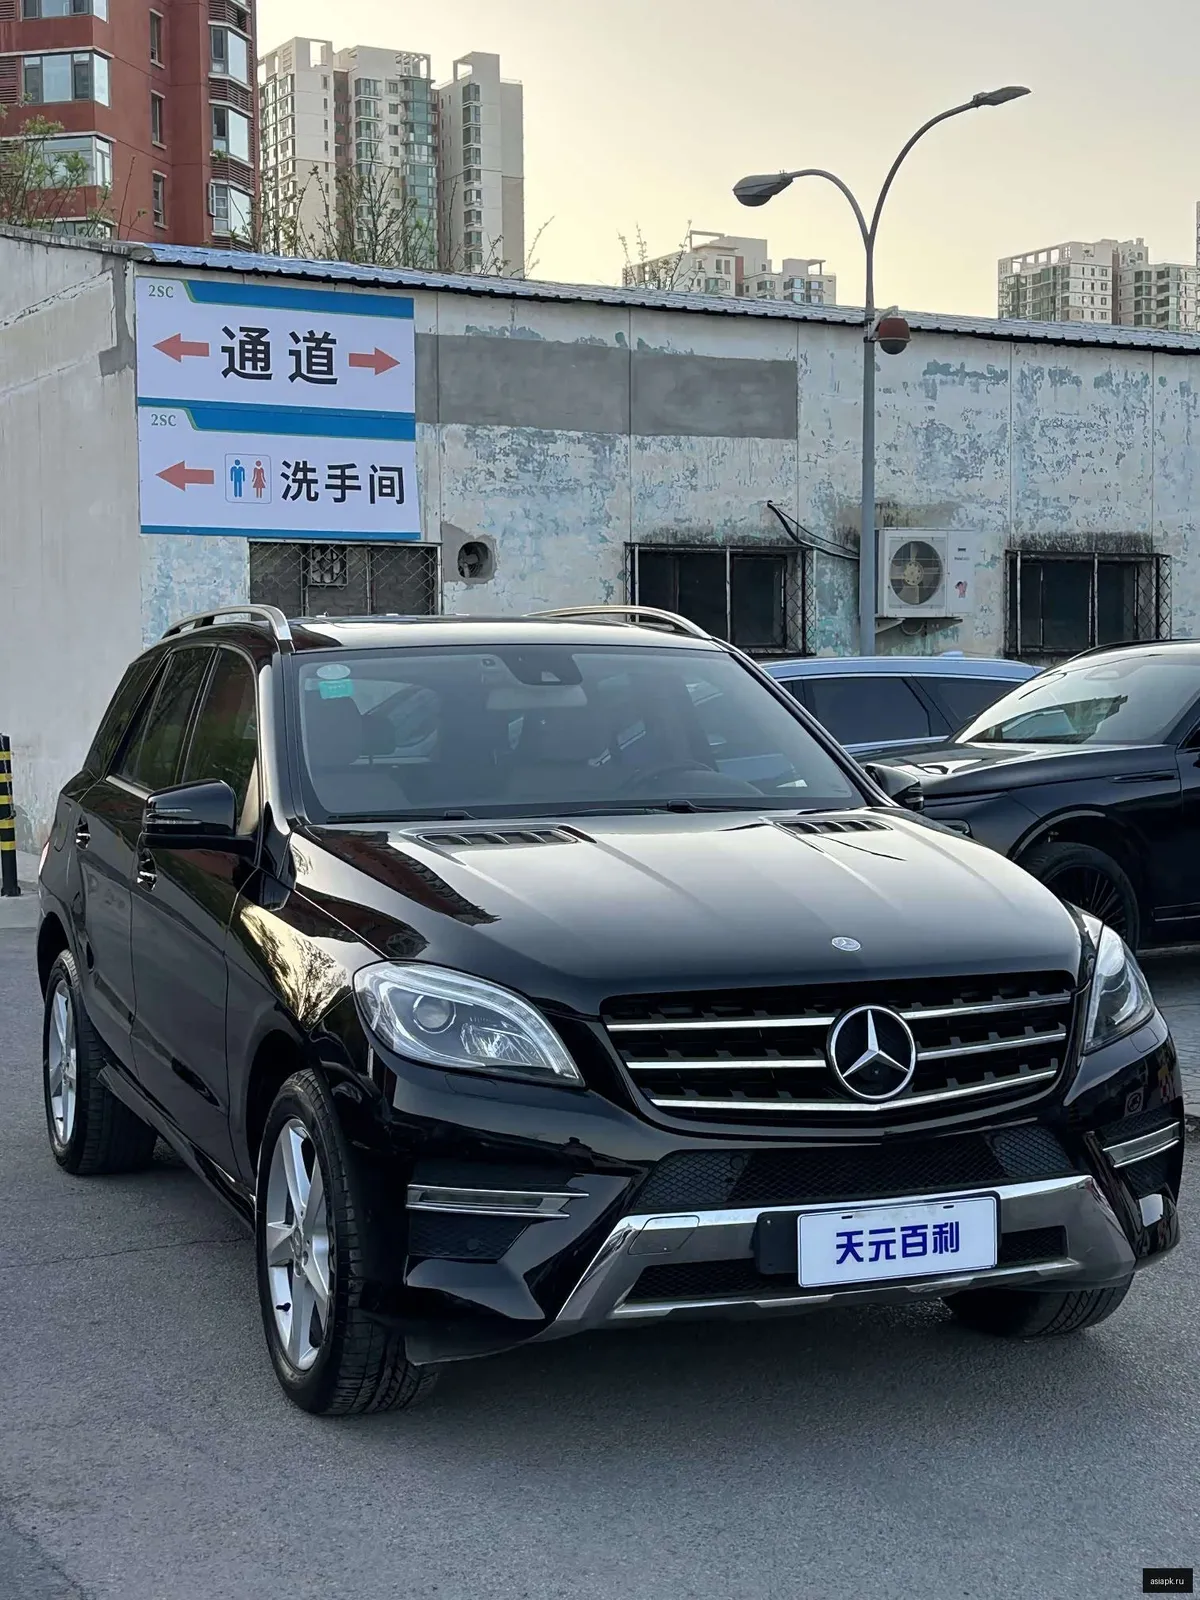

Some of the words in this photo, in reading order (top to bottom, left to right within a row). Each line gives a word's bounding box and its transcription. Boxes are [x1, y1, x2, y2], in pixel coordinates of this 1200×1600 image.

[148, 284, 174, 298] 2SC
[220, 325, 338, 385] 通道
[150, 413, 177, 427] 2SC
[279, 460, 405, 504] 洗手间
[835, 1220, 960, 1265] 天元百利
